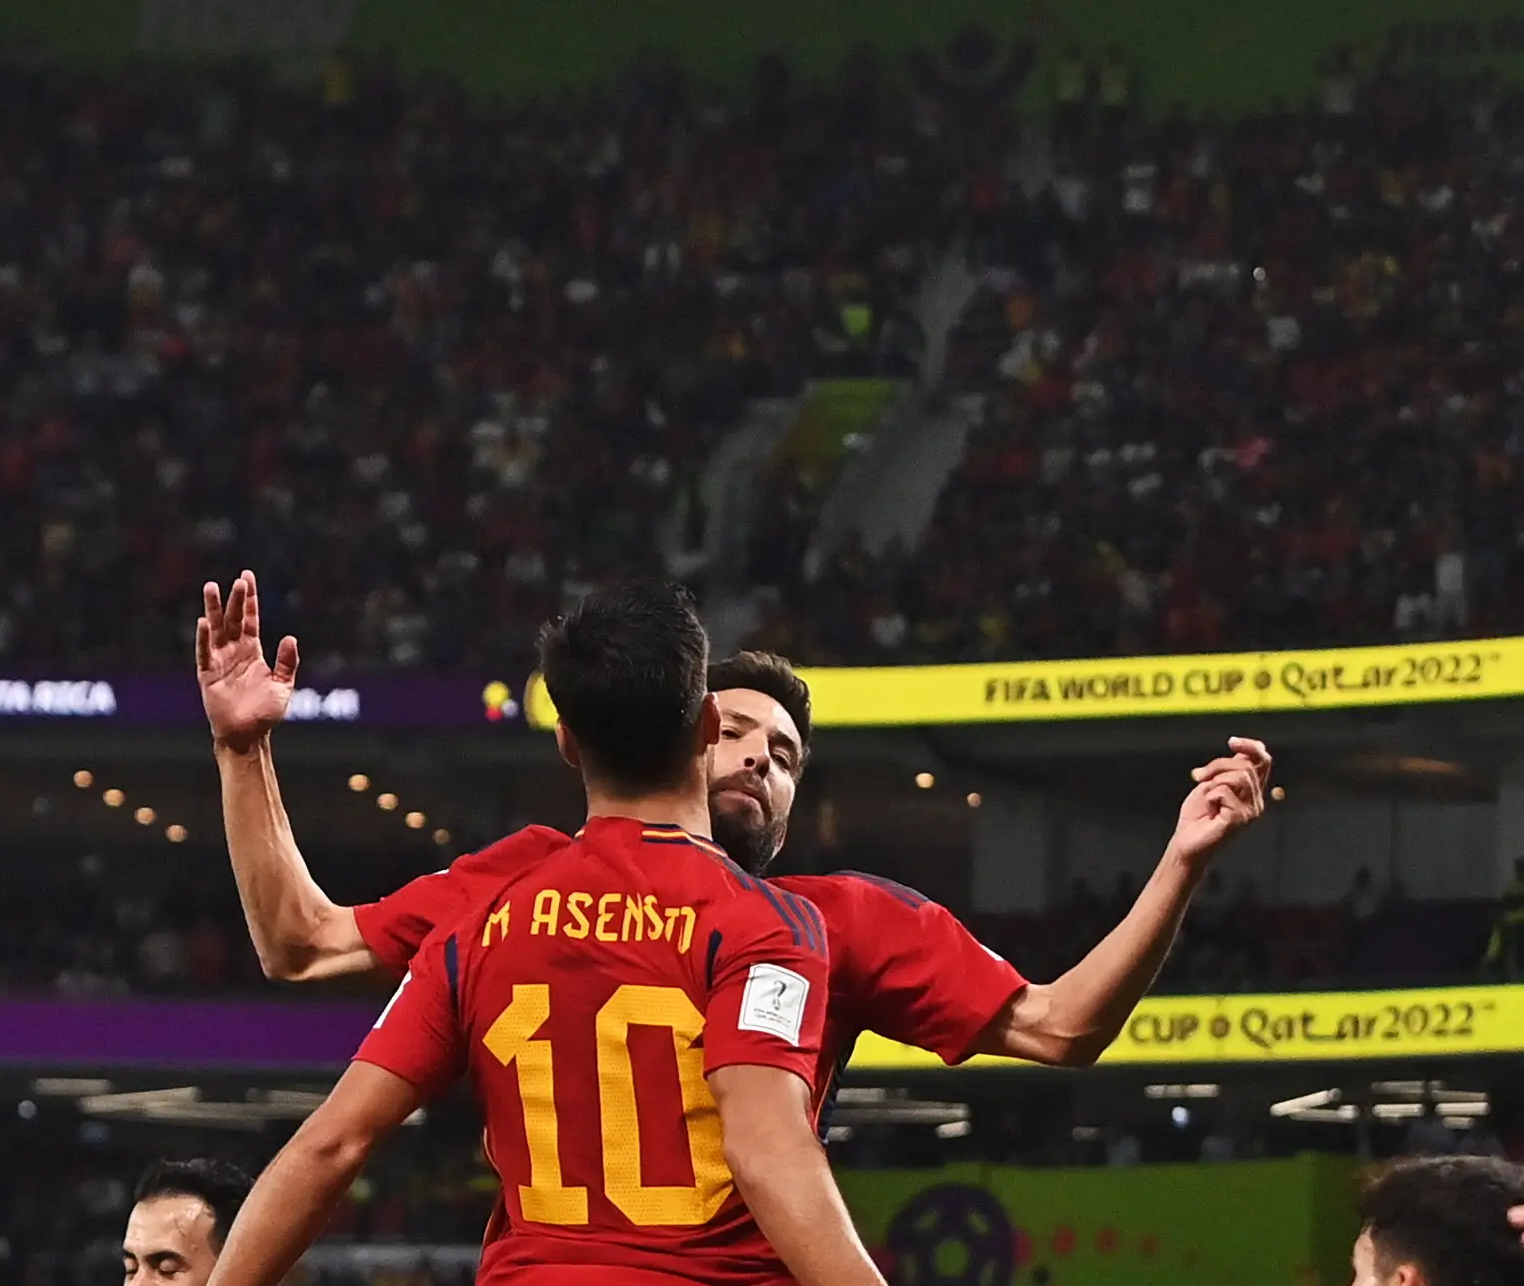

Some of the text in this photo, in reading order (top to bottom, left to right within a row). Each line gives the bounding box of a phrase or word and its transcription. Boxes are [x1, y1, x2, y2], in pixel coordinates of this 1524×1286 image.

[985, 675, 1051, 702] FIFA
[1058, 670, 1175, 700] WORLD
[1183, 668, 1244, 695] CUP
[1128, 1013, 1199, 1044] CUP
[481, 983, 733, 1226] 10
